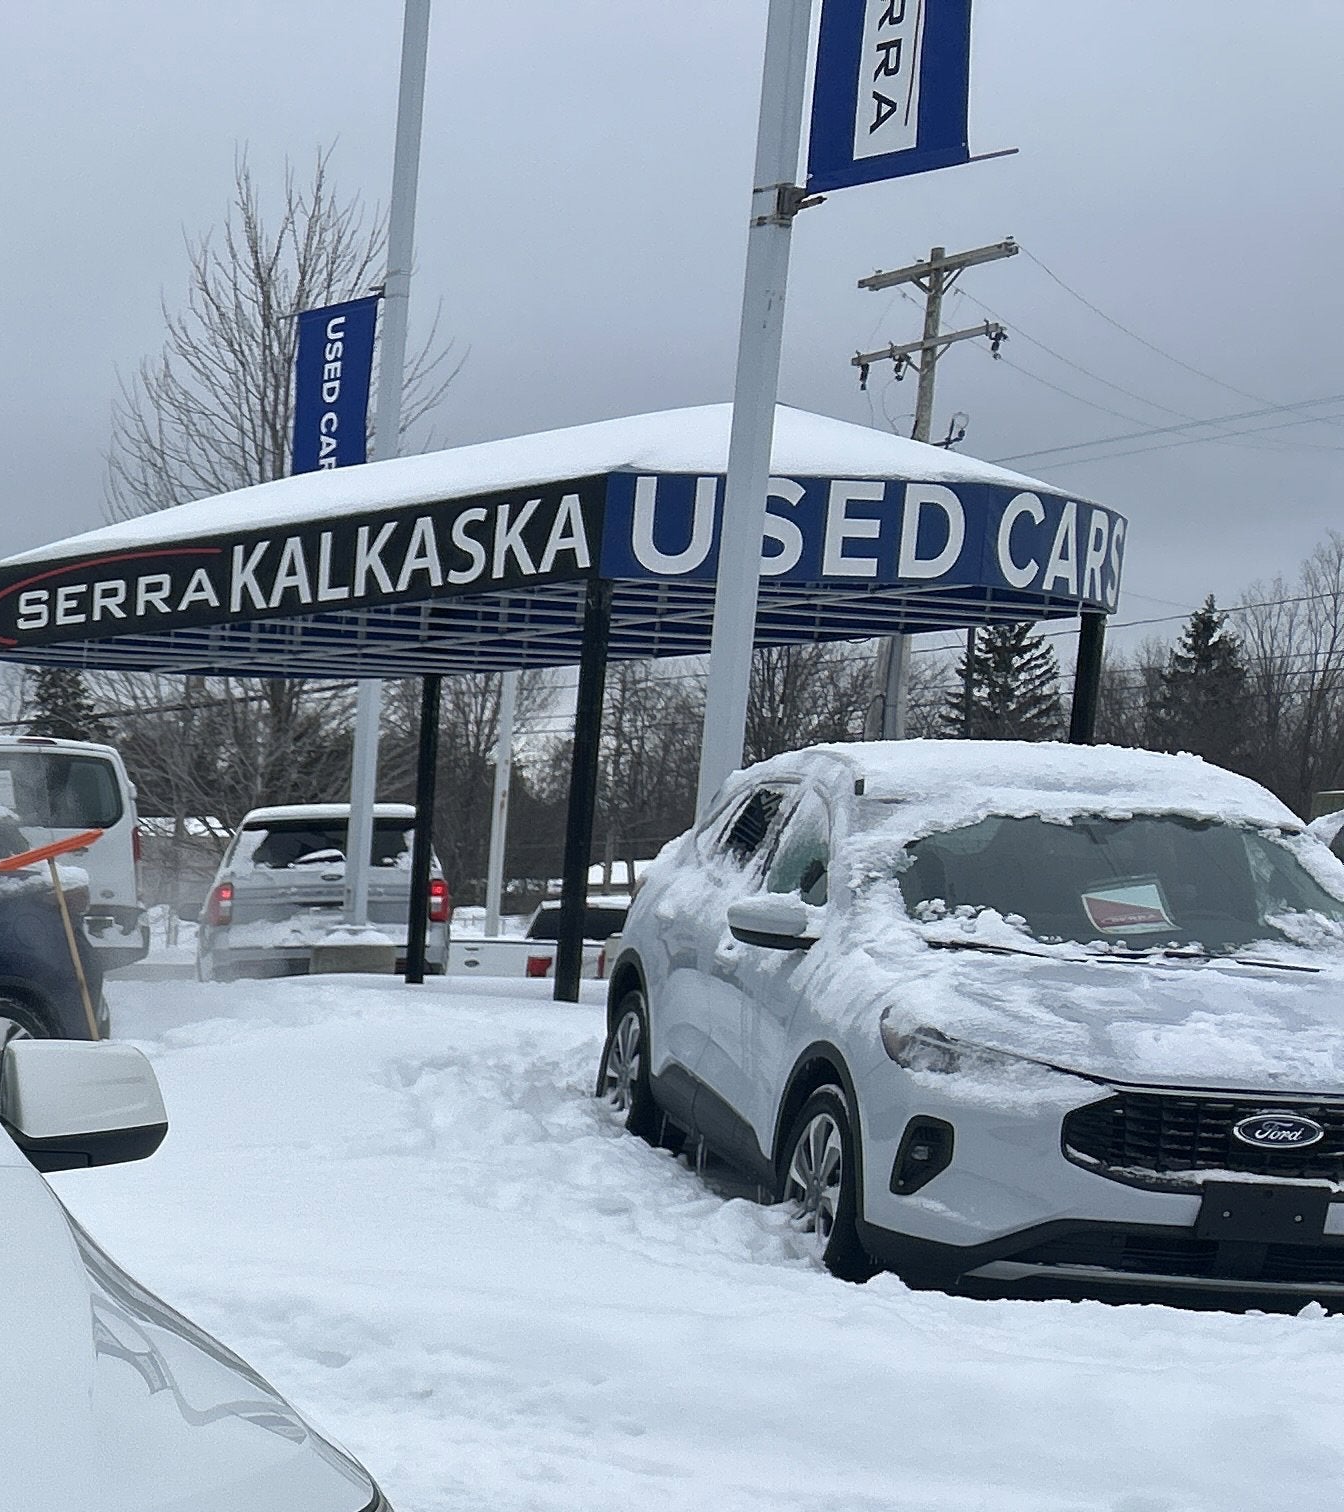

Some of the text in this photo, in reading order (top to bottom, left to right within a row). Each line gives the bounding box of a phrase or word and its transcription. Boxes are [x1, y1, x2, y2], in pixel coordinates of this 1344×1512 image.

[322, 316, 347, 404] USED
[15, 493, 592, 630] SERRA KALKASKA
[630, 475, 1128, 608] USED CARS
[1254, 1120, 1305, 1141] Ford
